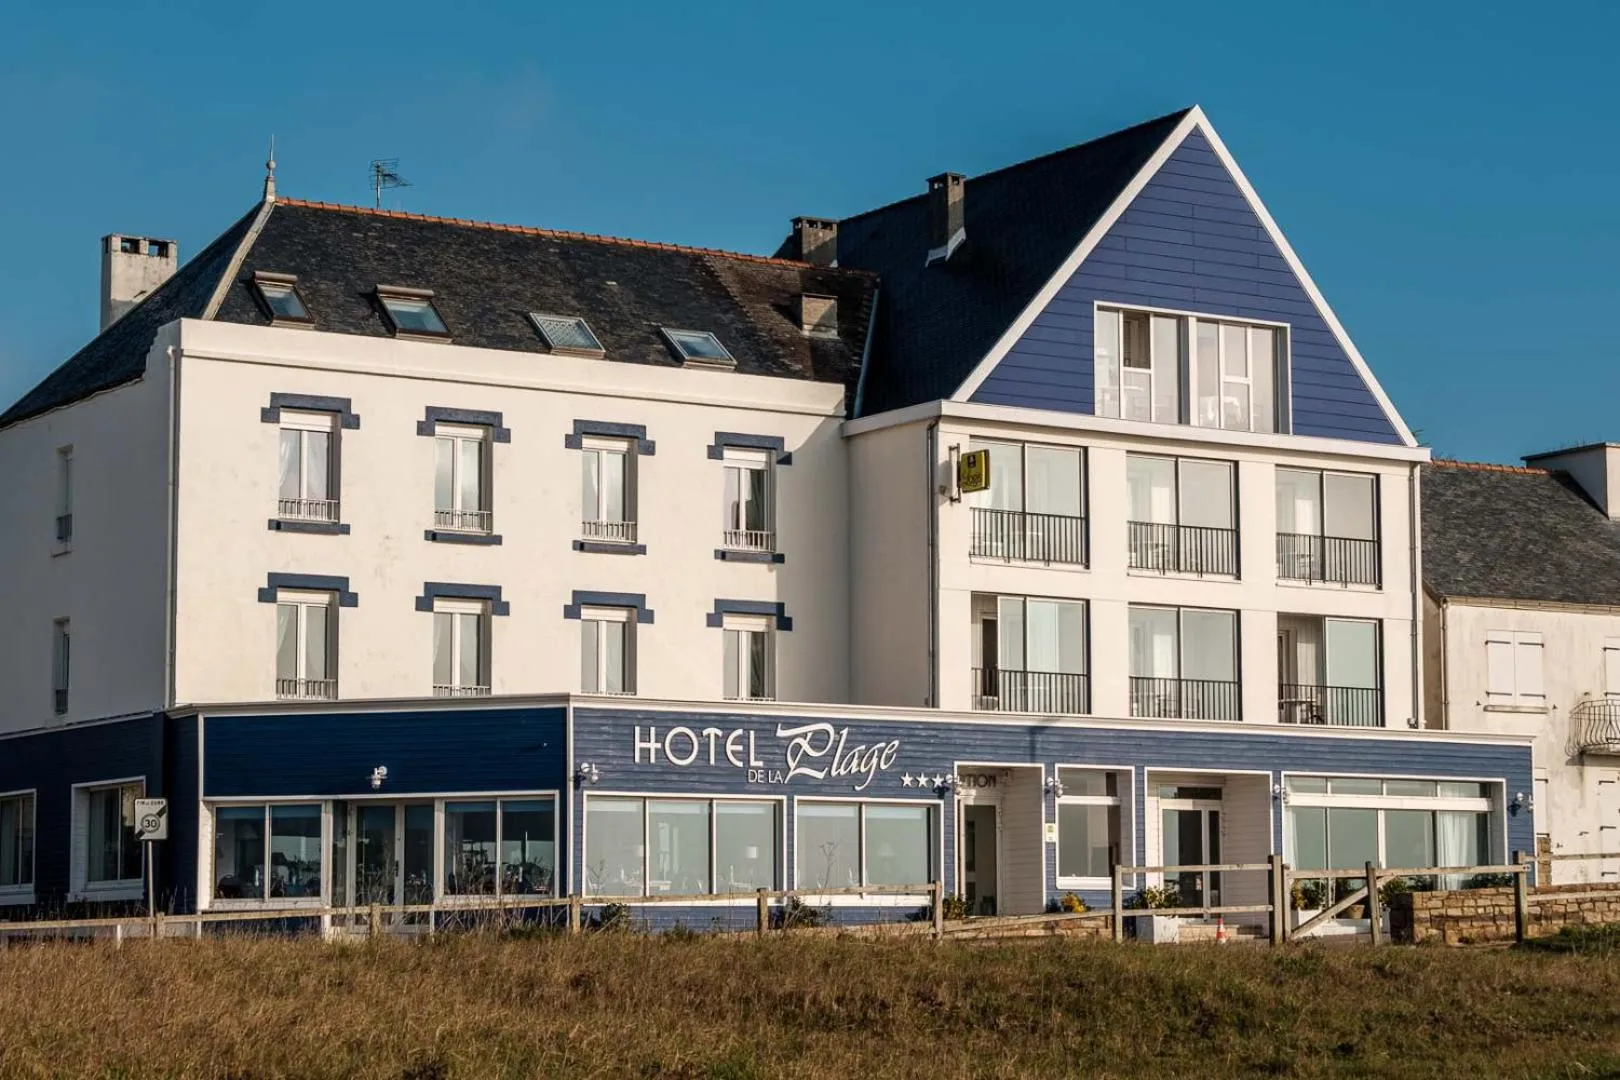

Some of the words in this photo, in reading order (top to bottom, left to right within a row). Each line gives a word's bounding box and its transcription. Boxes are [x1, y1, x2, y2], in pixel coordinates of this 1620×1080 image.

[633, 725, 764, 768] HOTEL
[747, 769, 765, 783] DE
[768, 771, 783, 784] LA
[776, 722, 900, 791] Plage
[144, 819, 157, 829] 30
